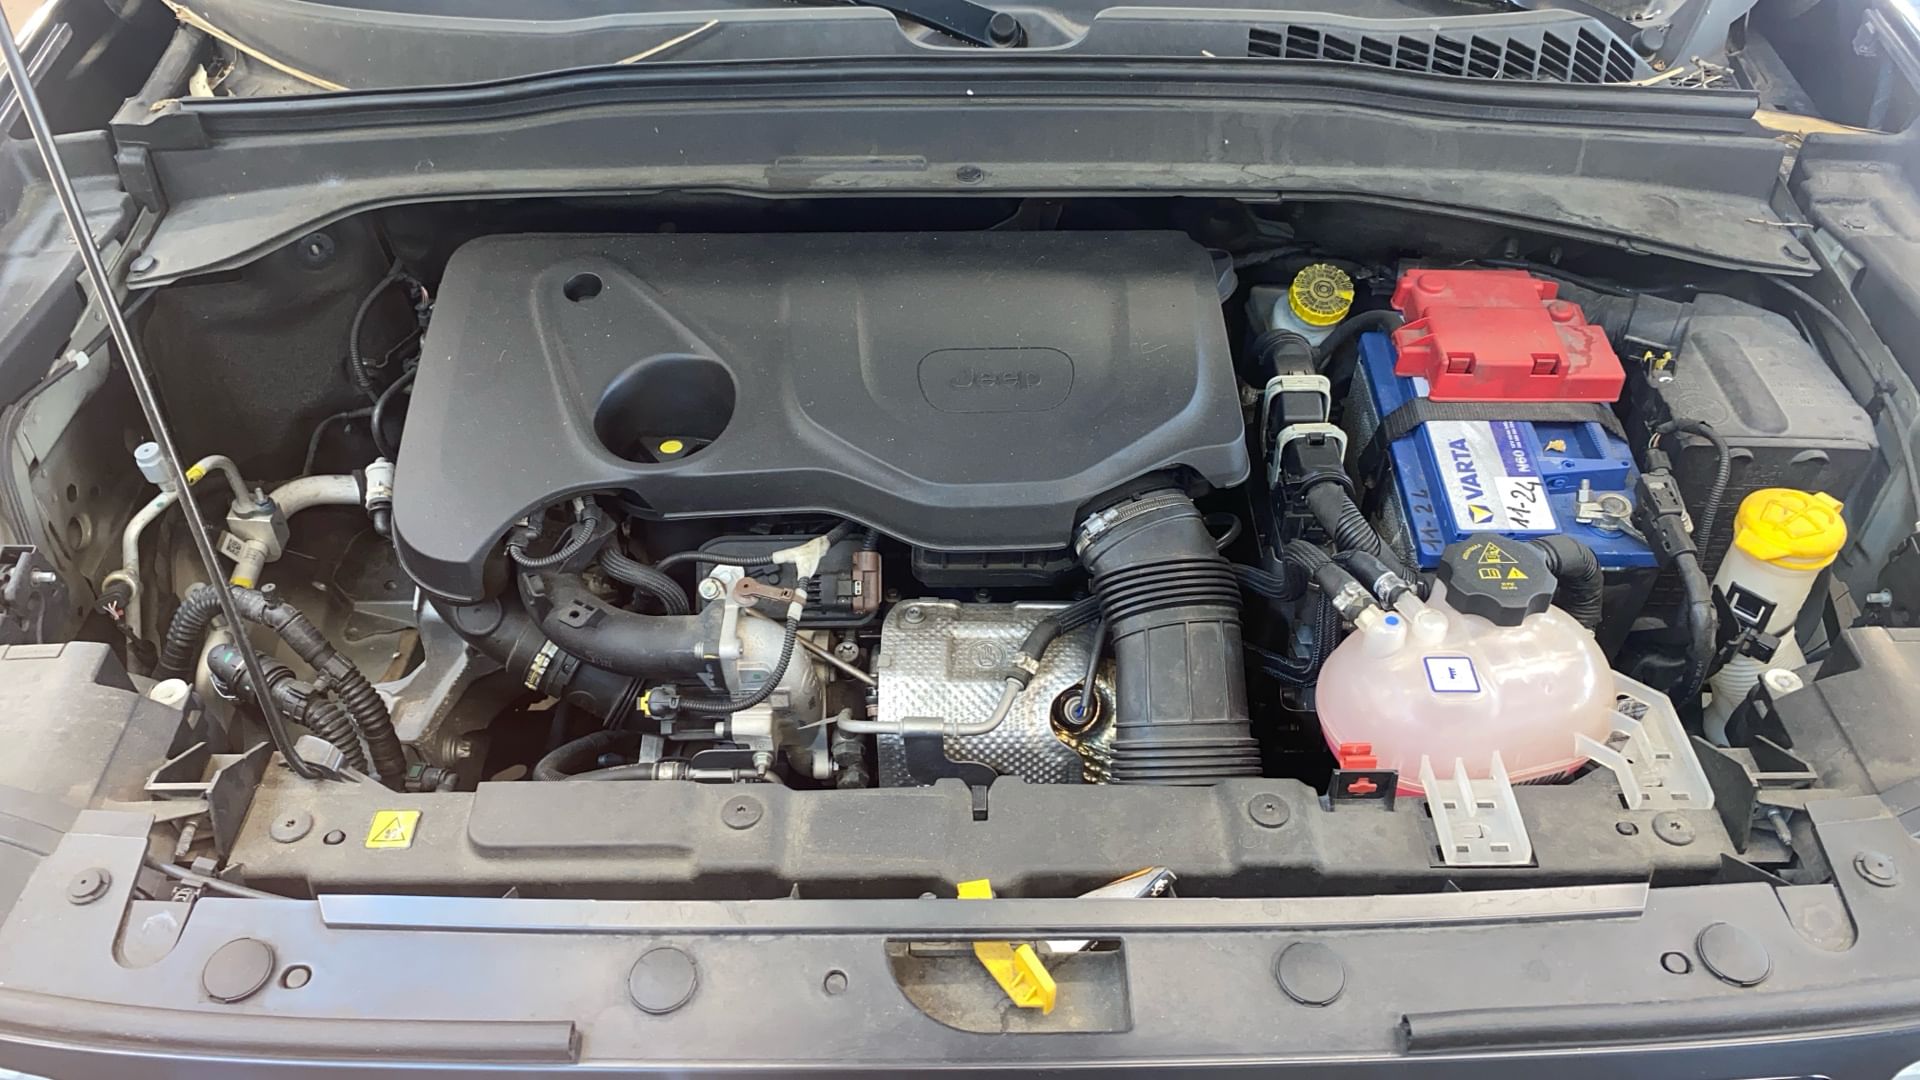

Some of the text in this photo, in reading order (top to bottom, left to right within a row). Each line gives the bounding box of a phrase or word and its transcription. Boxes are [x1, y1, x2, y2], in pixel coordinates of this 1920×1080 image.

[950, 367, 1042, 392] Jeep
[1448, 437, 1484, 500] VARTA
[1512, 449, 1532, 473] N60
[1506, 481, 1544, 529] 11-24
